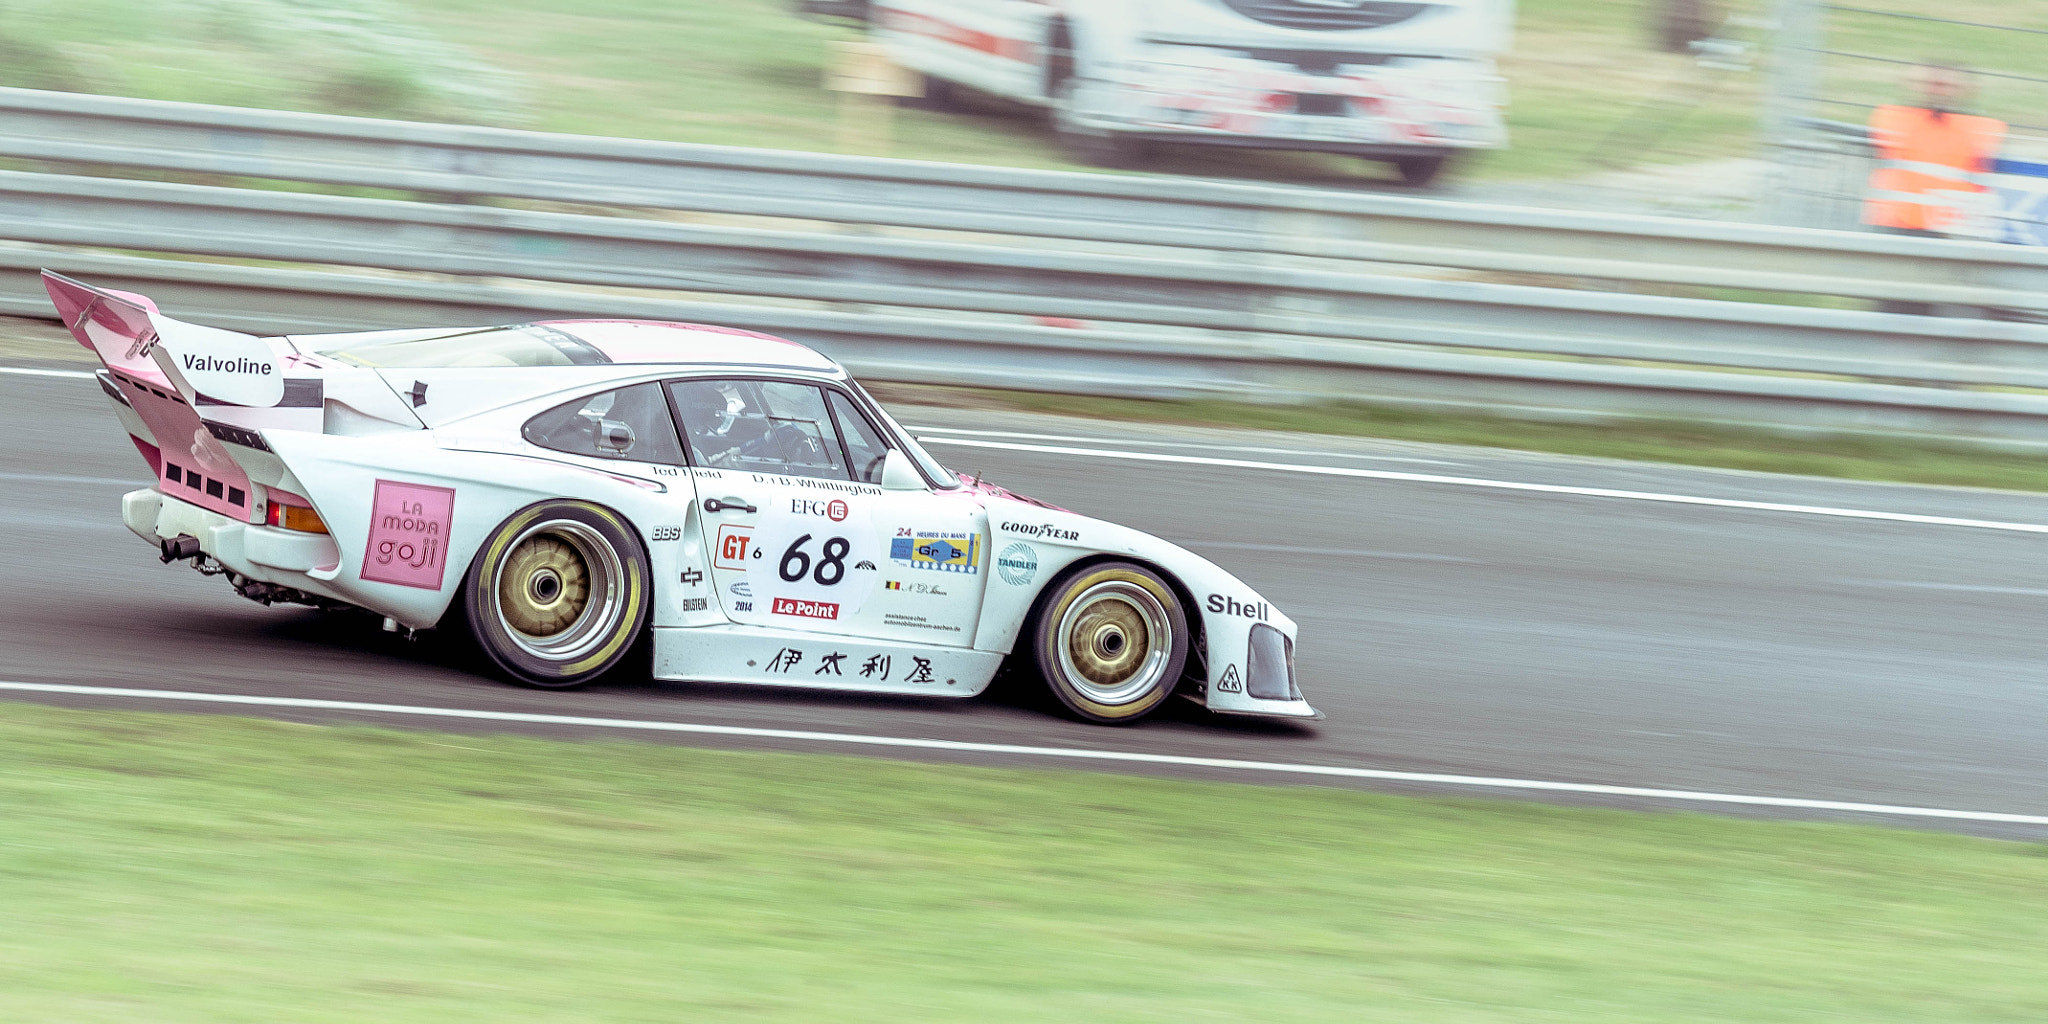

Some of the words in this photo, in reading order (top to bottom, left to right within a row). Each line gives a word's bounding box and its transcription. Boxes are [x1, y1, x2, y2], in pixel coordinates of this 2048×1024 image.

[183, 354, 272, 376] Valvoline
[402, 501, 423, 516] LA
[790, 498, 826, 516] EFG
[652, 526, 681, 541] BBS
[896, 527, 912, 537] 24
[950, 532, 967, 540] MANS
[1000, 521, 1080, 541] GOODYEAR
[376, 538, 439, 570] goji
[722, 534, 751, 561] GT
[752, 547, 763, 560] 6
[918, 545, 940, 557] Gr
[950, 548, 962, 559] 5
[779, 534, 851, 586] 68
[998, 558, 1037, 571] TANDLER
[682, 598, 708, 612] BILSTEIN
[735, 601, 753, 613] 2014
[777, 600, 795, 614] Le
[795, 601, 835, 618] Point
[1206, 593, 1269, 621] Shell
